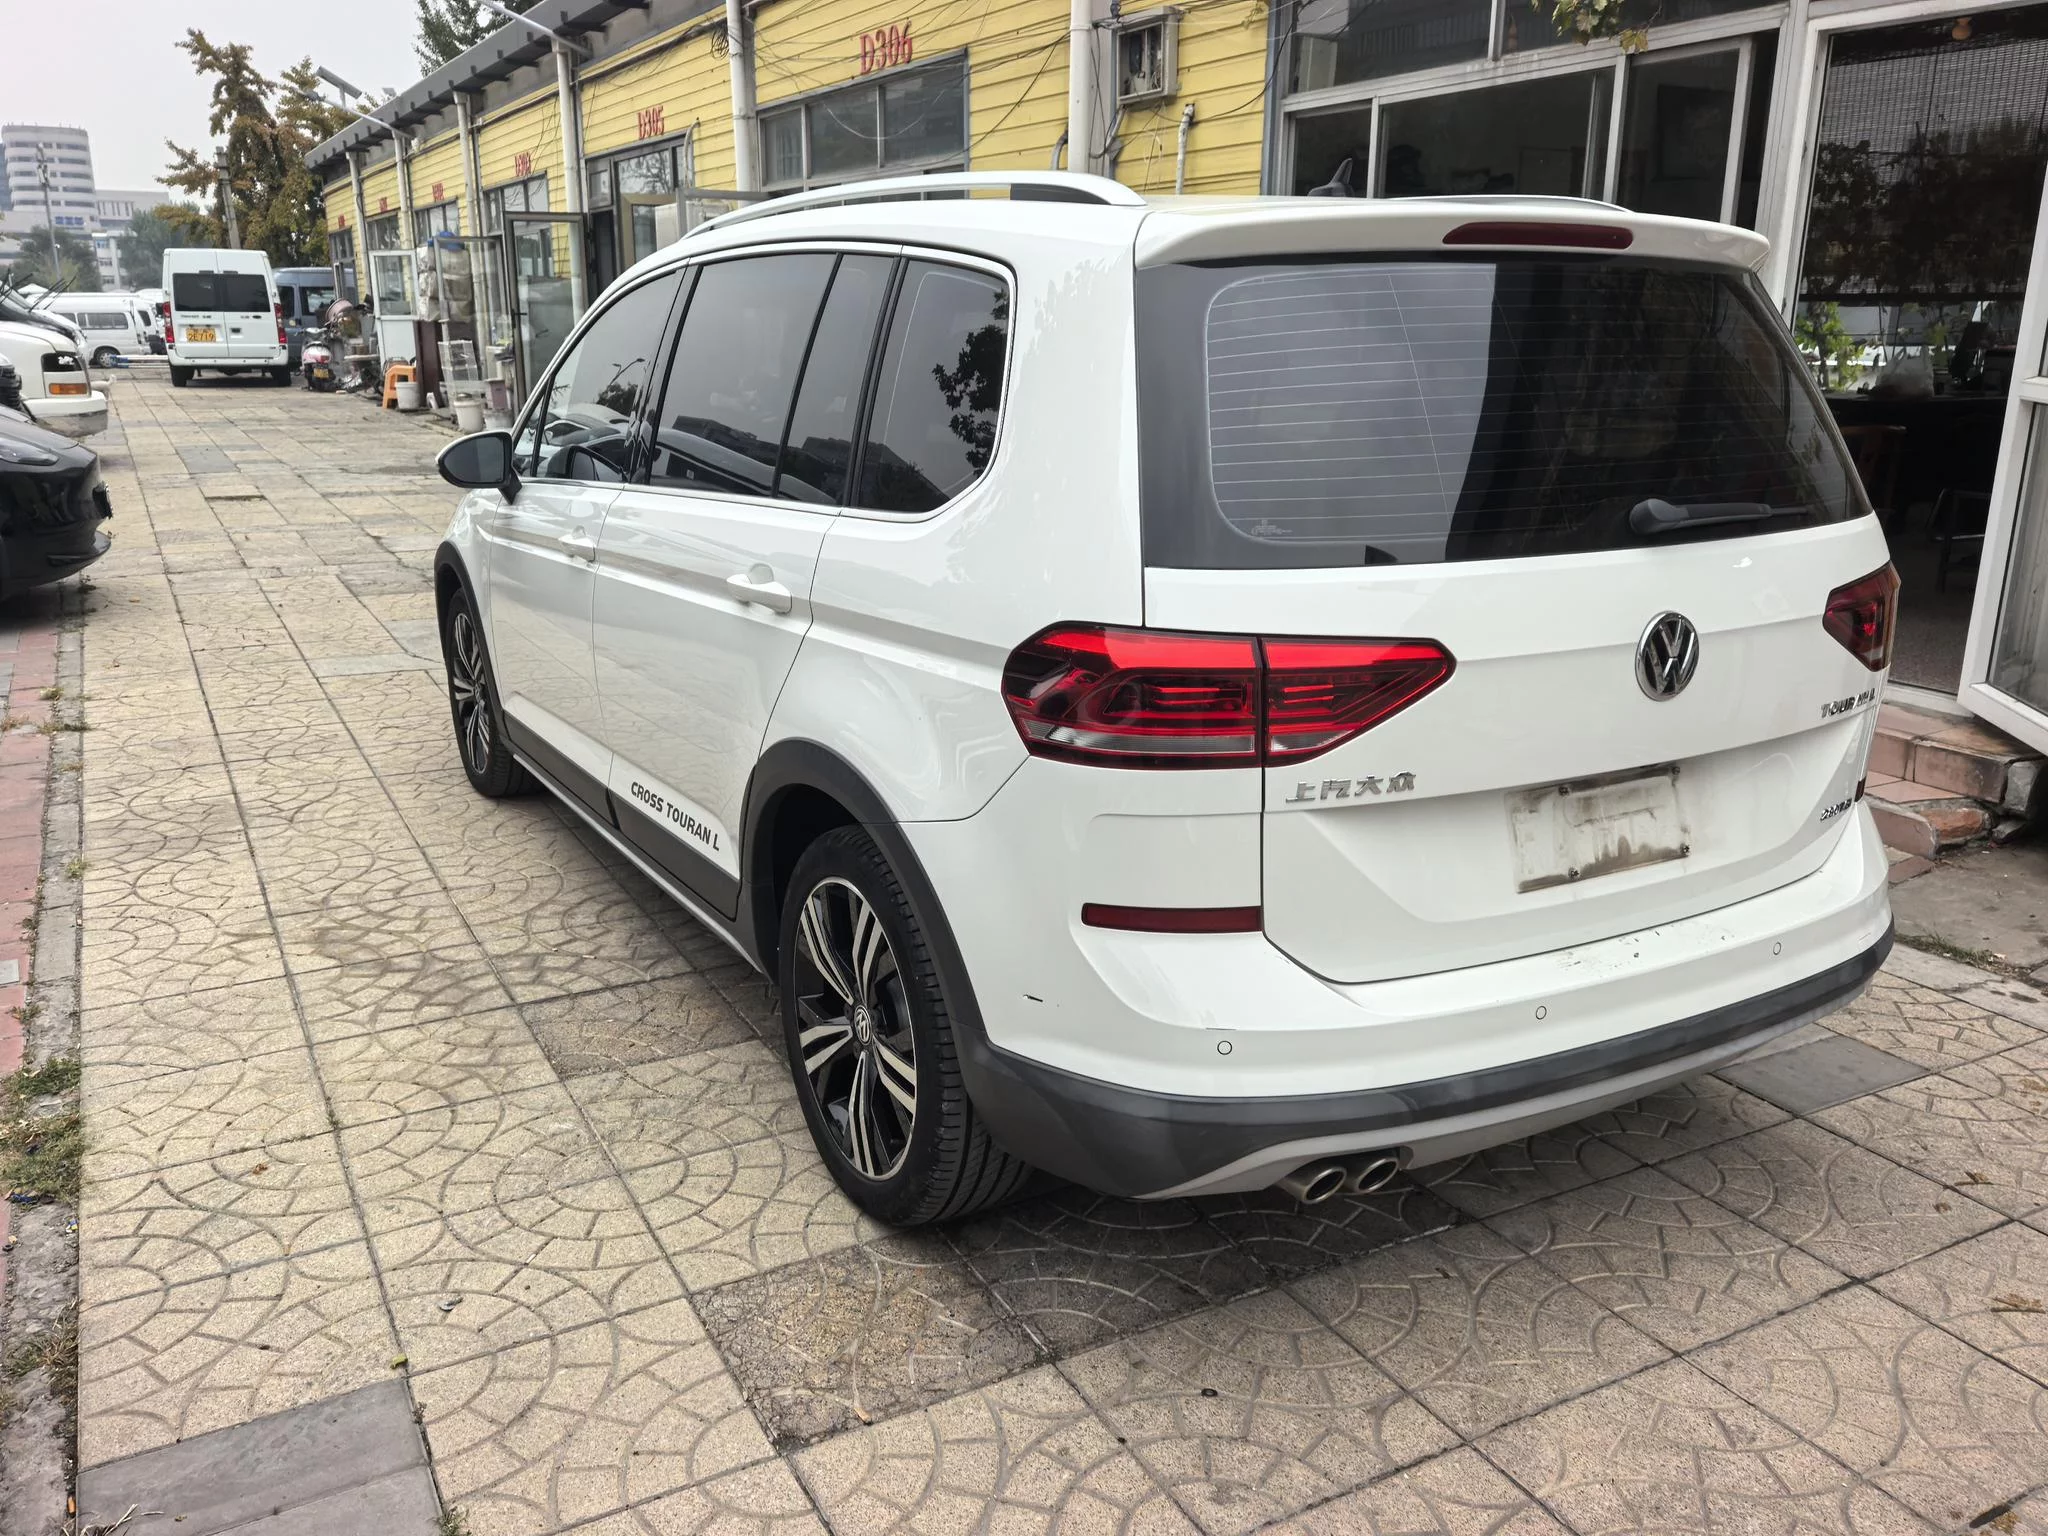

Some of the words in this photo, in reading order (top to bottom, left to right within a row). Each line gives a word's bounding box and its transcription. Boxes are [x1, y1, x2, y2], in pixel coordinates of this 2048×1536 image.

[859, 20, 912, 75] D306
[637, 104, 664, 140] D305
[1285, 770, 1416, 803] 上汽大众
[631, 781, 664, 813] CROSS
[666, 802, 711, 845] TOURAN
[712, 833, 720, 851] L
